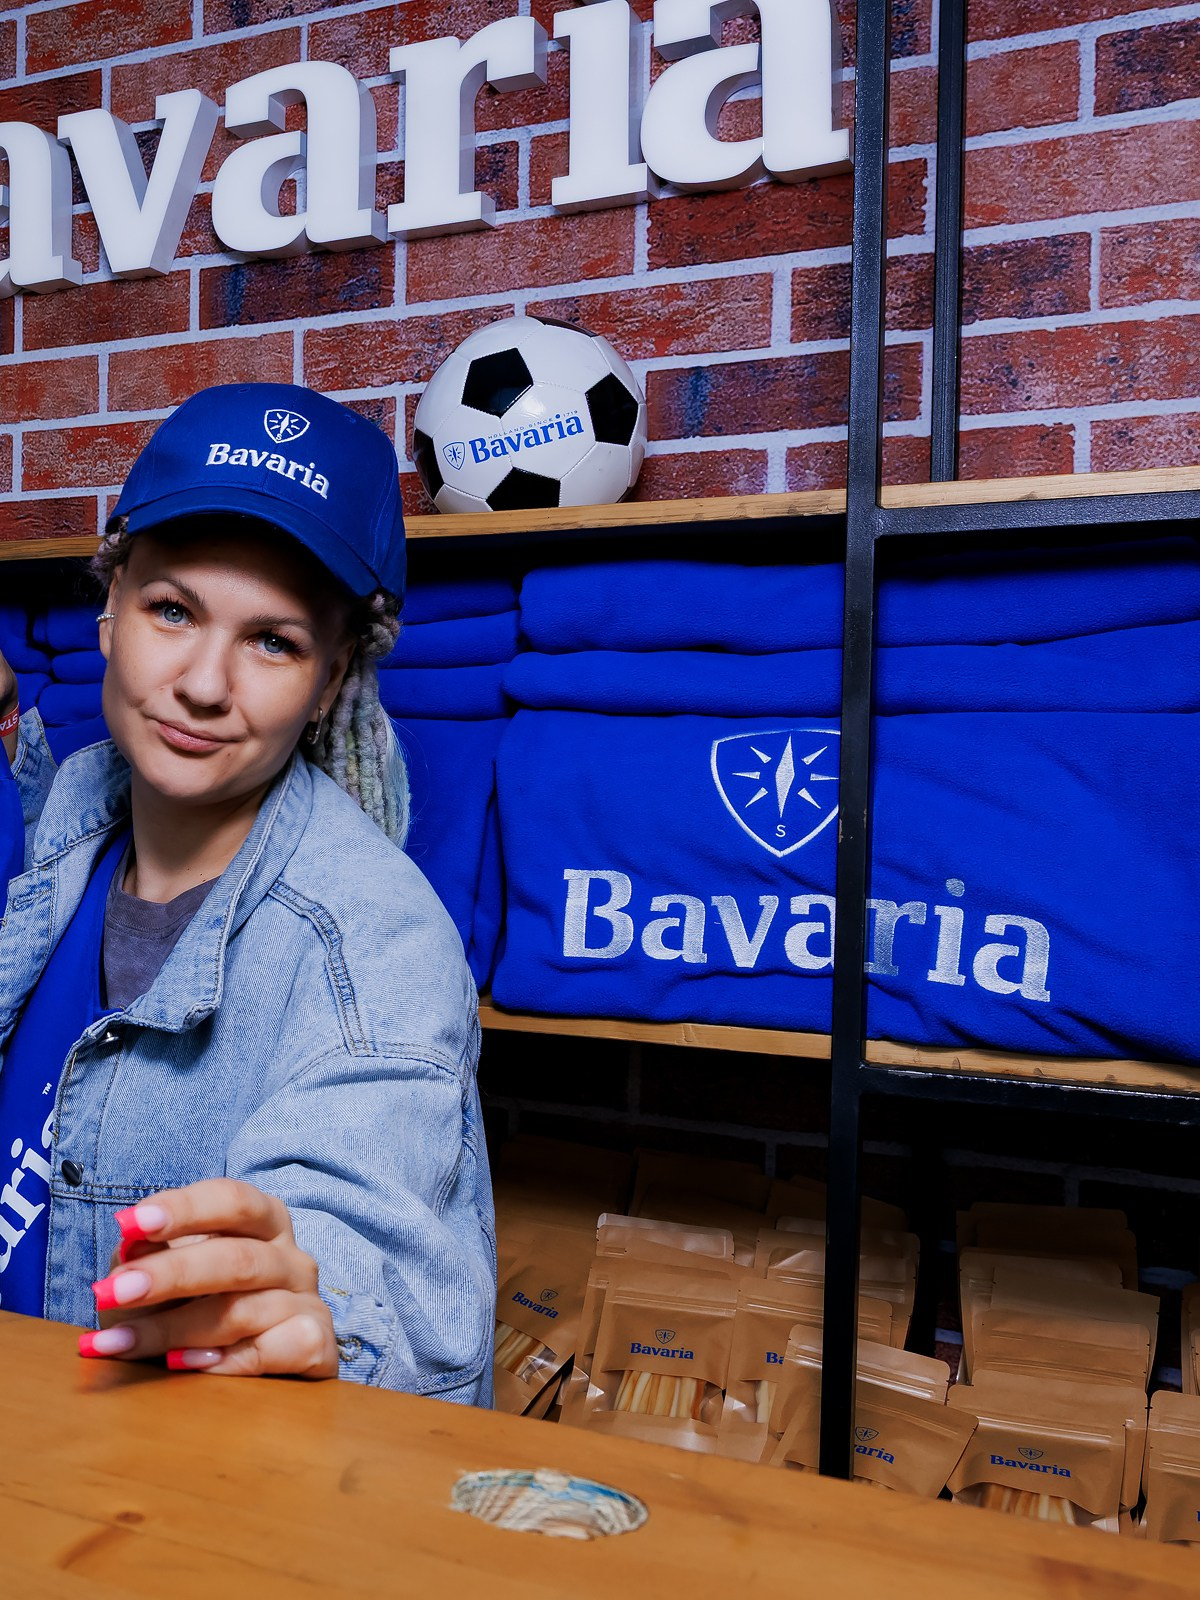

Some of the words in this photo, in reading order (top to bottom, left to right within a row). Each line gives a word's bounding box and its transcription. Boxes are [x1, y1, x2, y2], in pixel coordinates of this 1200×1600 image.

[468, 414, 584, 464] Bavaria
[488, 426, 525, 439] HOLLAND
[528, 417, 553, 428] SINCE
[206, 443, 330, 499] Bavaria
[562, 868, 1051, 1002] Bavaria
[511, 1291, 558, 1319] Bavaria
[630, 1342, 694, 1360] Bavaria
[990, 1454, 1071, 1478] Bavaria
